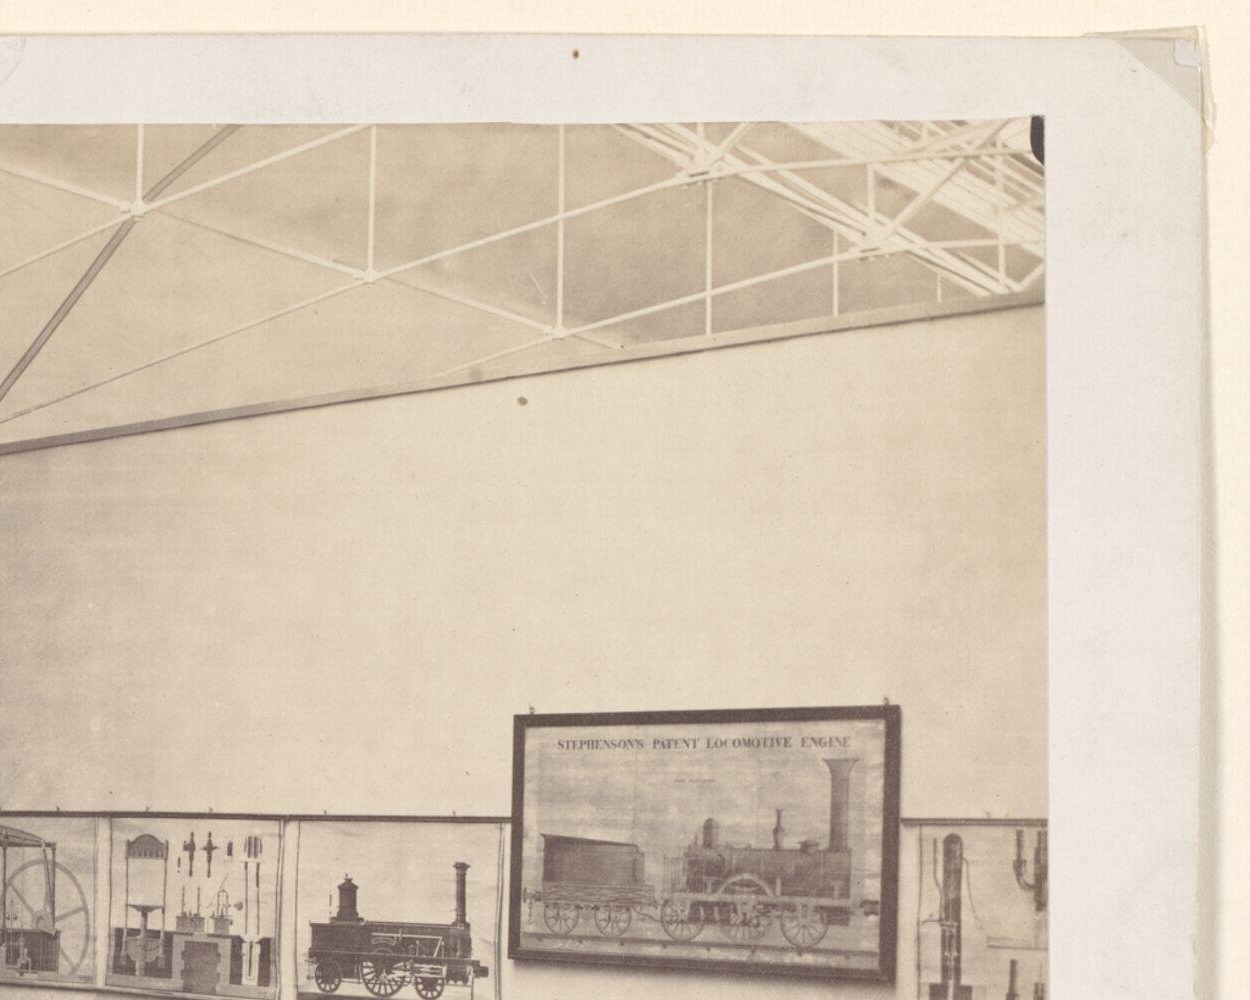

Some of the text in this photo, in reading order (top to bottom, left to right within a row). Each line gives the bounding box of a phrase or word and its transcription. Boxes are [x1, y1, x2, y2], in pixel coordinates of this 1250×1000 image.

[557, 736, 852, 751] STEPHENSON'S PATENT LOCOMOTIVE ENGINE
